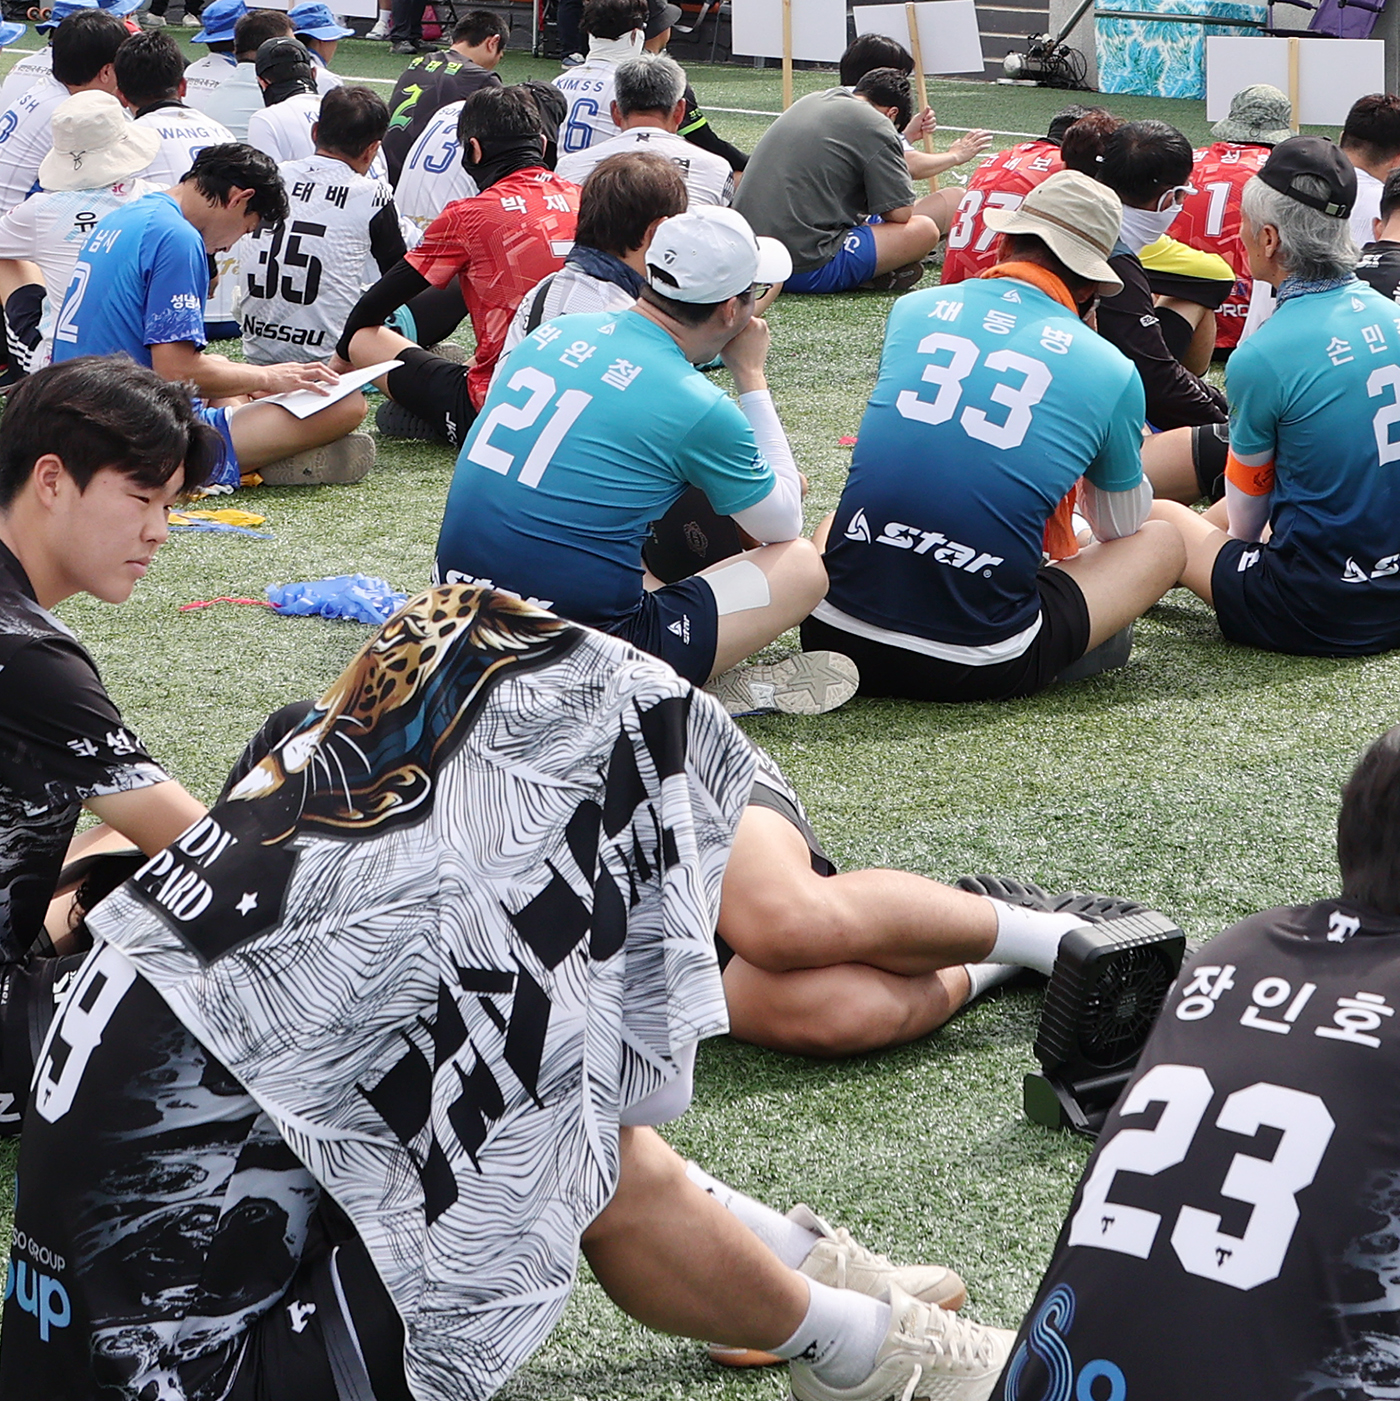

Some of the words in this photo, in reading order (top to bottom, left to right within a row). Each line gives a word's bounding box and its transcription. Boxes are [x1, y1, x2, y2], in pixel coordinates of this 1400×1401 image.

[555, 79, 579, 91] KIM
[156, 126, 210, 141] WANG
[408, 119, 462, 175] 13
[563, 97, 599, 152] 6
[948, 189, 1026, 252] 37
[1204, 181, 1233, 238] 1
[246, 219, 328, 306] 35
[56, 260, 92, 344] 2
[242, 313, 326, 347] Nassau
[927, 299, 1075, 356] 채동병
[531, 323, 643, 392] 박완철
[895, 331, 1054, 451] 33
[466, 365, 594, 490] 21
[874, 520, 1005, 575] star
[1173, 962, 1395, 1050] 장인호
[1068, 1062, 1337, 1291] 23
[27, 1232, 67, 1273] GROUP
